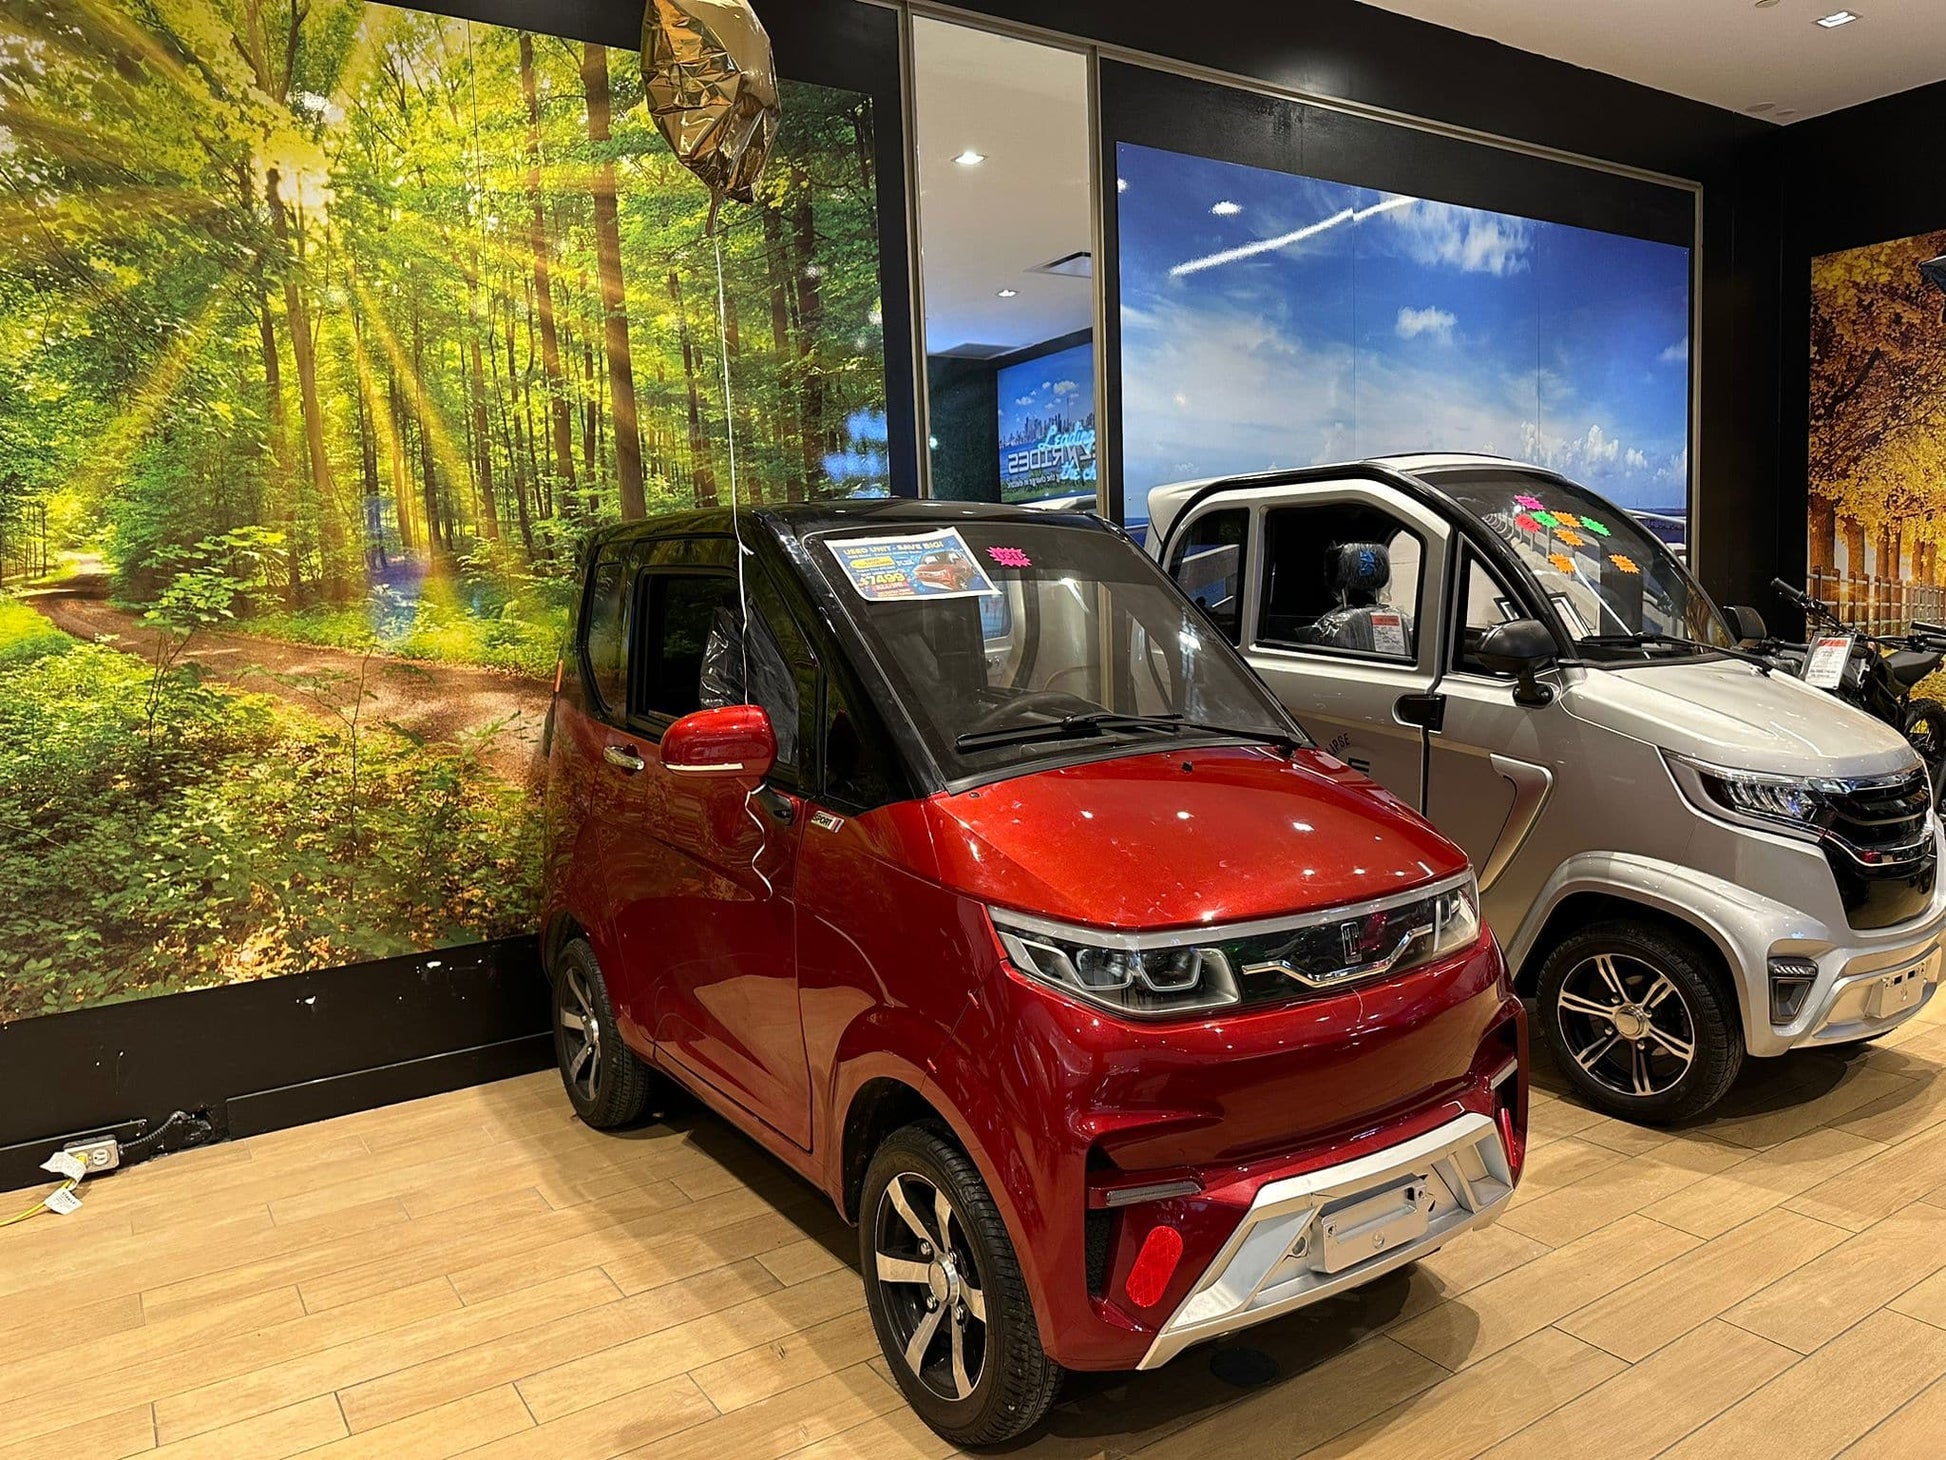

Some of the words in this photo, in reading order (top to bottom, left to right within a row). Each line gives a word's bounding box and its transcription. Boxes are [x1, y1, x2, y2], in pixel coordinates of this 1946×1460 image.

[843, 546, 869, 556] USED
[870, 544, 892, 554] UNIT
[896, 542, 922, 551] SAVE
